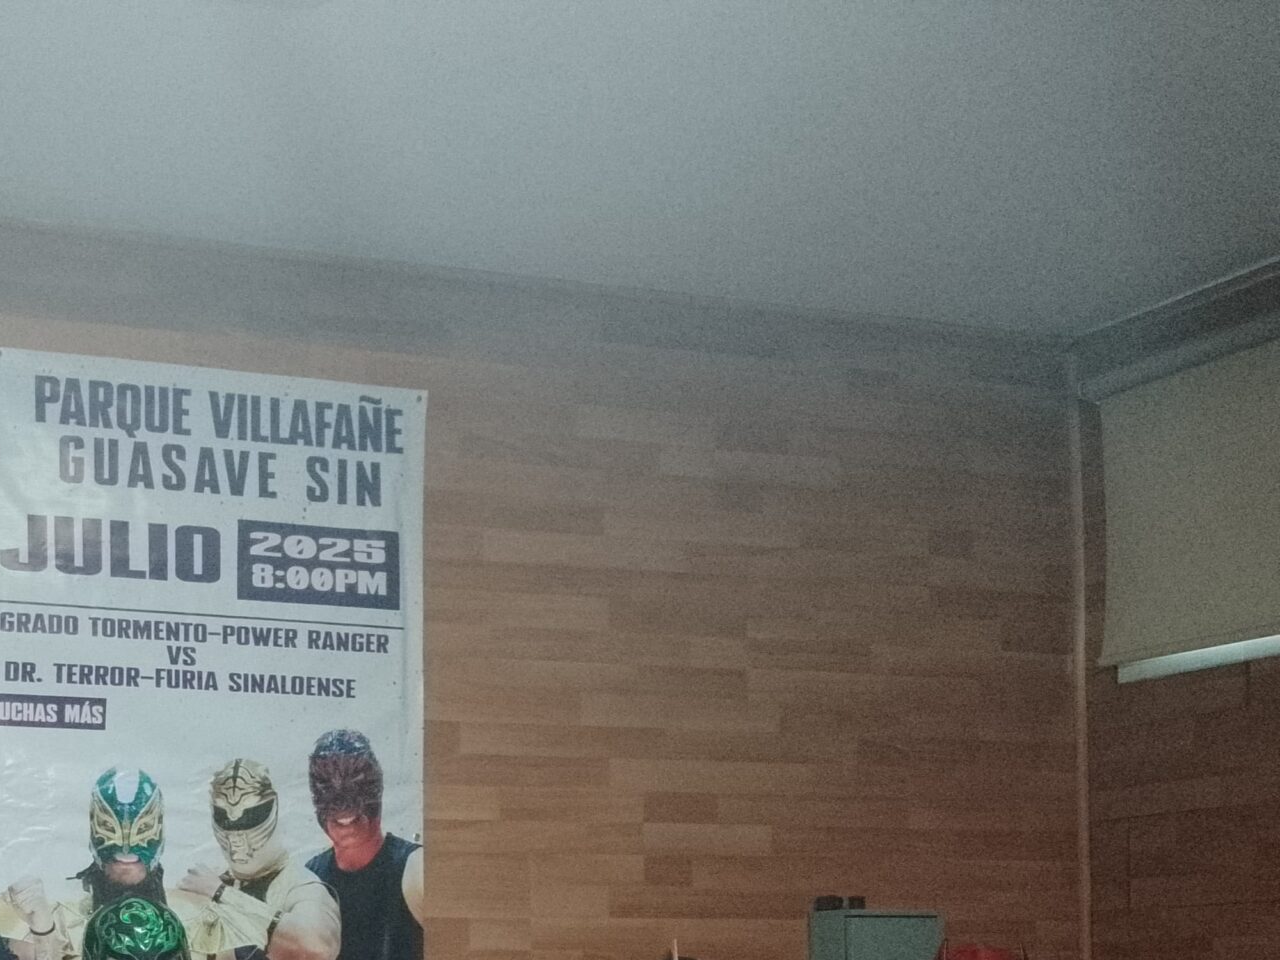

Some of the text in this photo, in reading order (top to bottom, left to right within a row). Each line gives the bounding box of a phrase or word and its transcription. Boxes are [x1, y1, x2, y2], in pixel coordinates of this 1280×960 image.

[35, 375, 404, 454] PARQUE VILLAFAÑE
[59, 435, 382, 507] GUASAVE SIN
[0, 514, 221, 583] JULIO
[249, 531, 386, 564] 2025
[251, 564, 387, 595] 8:00PM
[89, 617, 297, 649] TORMENTO-POWER
[308, 630, 389, 654] RANGER
[166, 645, 196, 666] VS
[5, 661, 356, 699] DR. TERROR-FURIA SINALOENSE
[64, 701, 104, 724] MÁS
